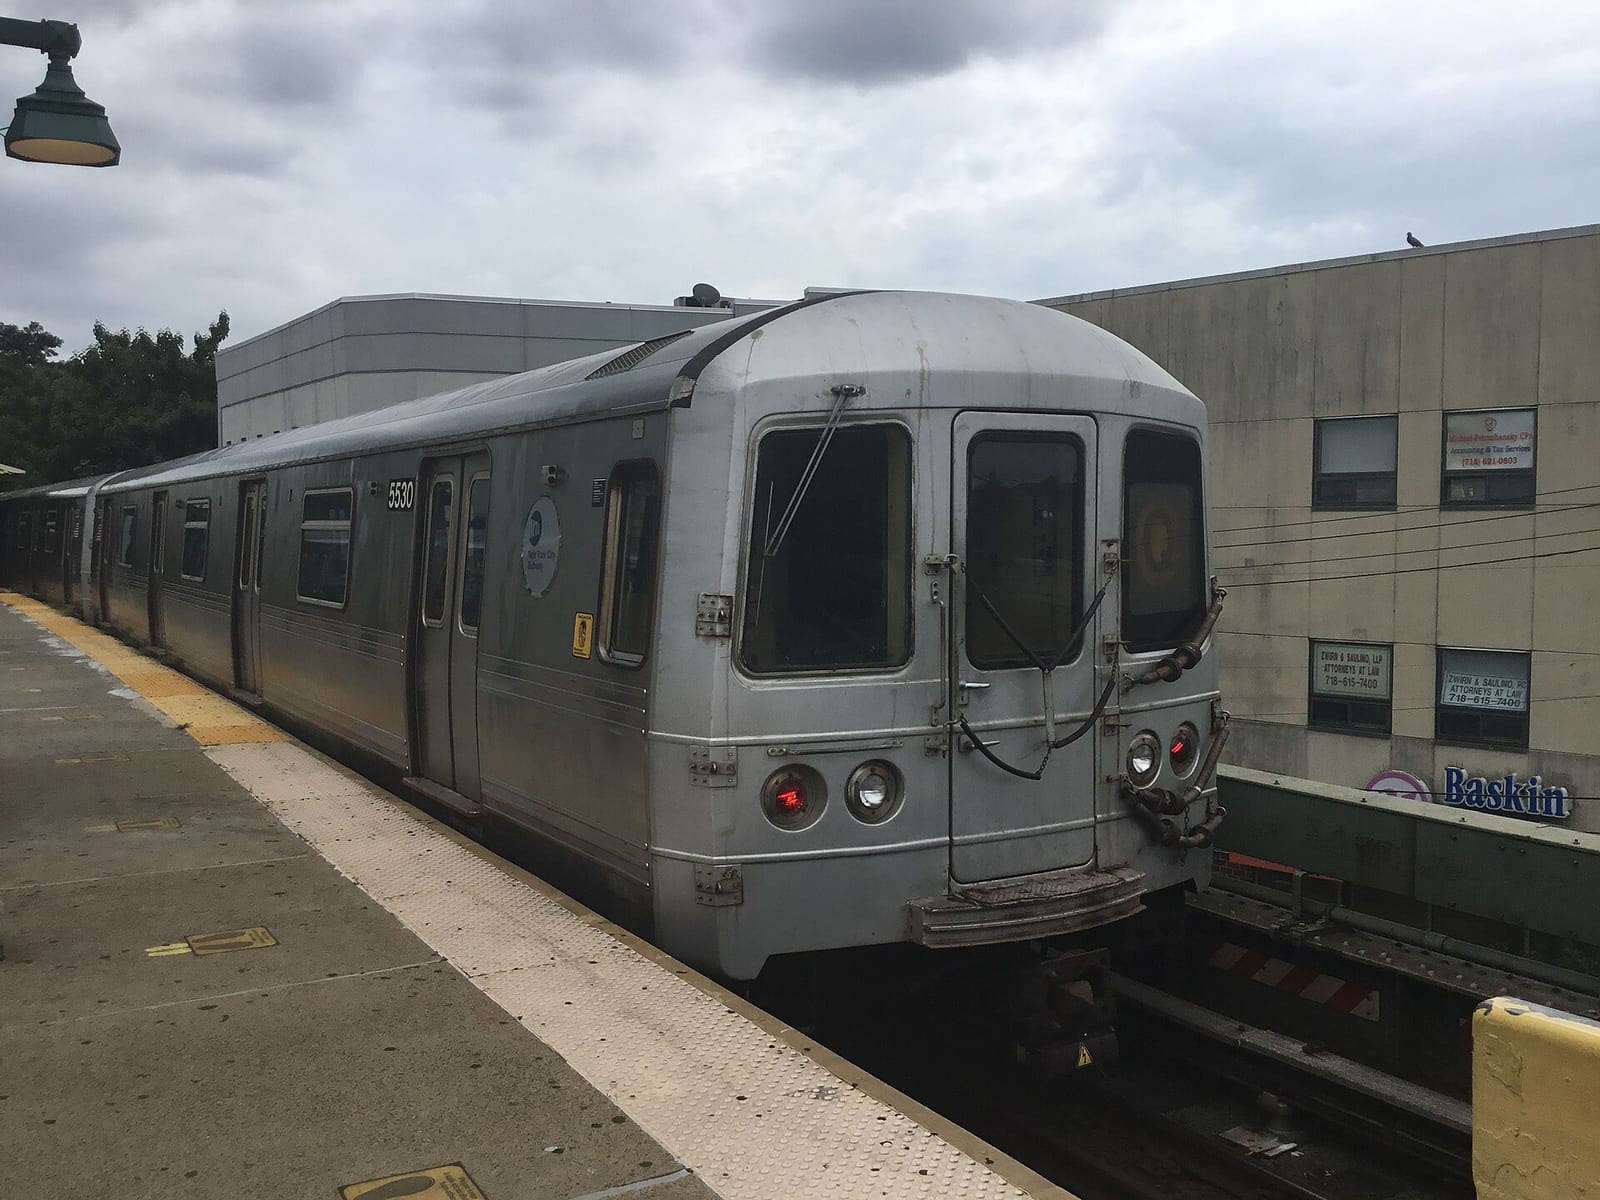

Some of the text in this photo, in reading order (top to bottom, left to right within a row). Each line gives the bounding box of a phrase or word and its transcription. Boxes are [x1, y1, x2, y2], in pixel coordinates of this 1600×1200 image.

[1493, 445, 1503, 453] Tax
[1505, 445, 1531, 453] Services
[388, 481, 414, 509] 5530
[1324, 664, 1380, 676] ATTORNEYS AT LAW
[1325, 676, 1378, 689] 718-615-7400
[1474, 678, 1479, 686] &
[1450, 685, 1523, 698] ATTORNEYS AT LAW
[1449, 693, 1520, 707] 718-615-7400
[1444, 766, 1569, 818] Baskin
